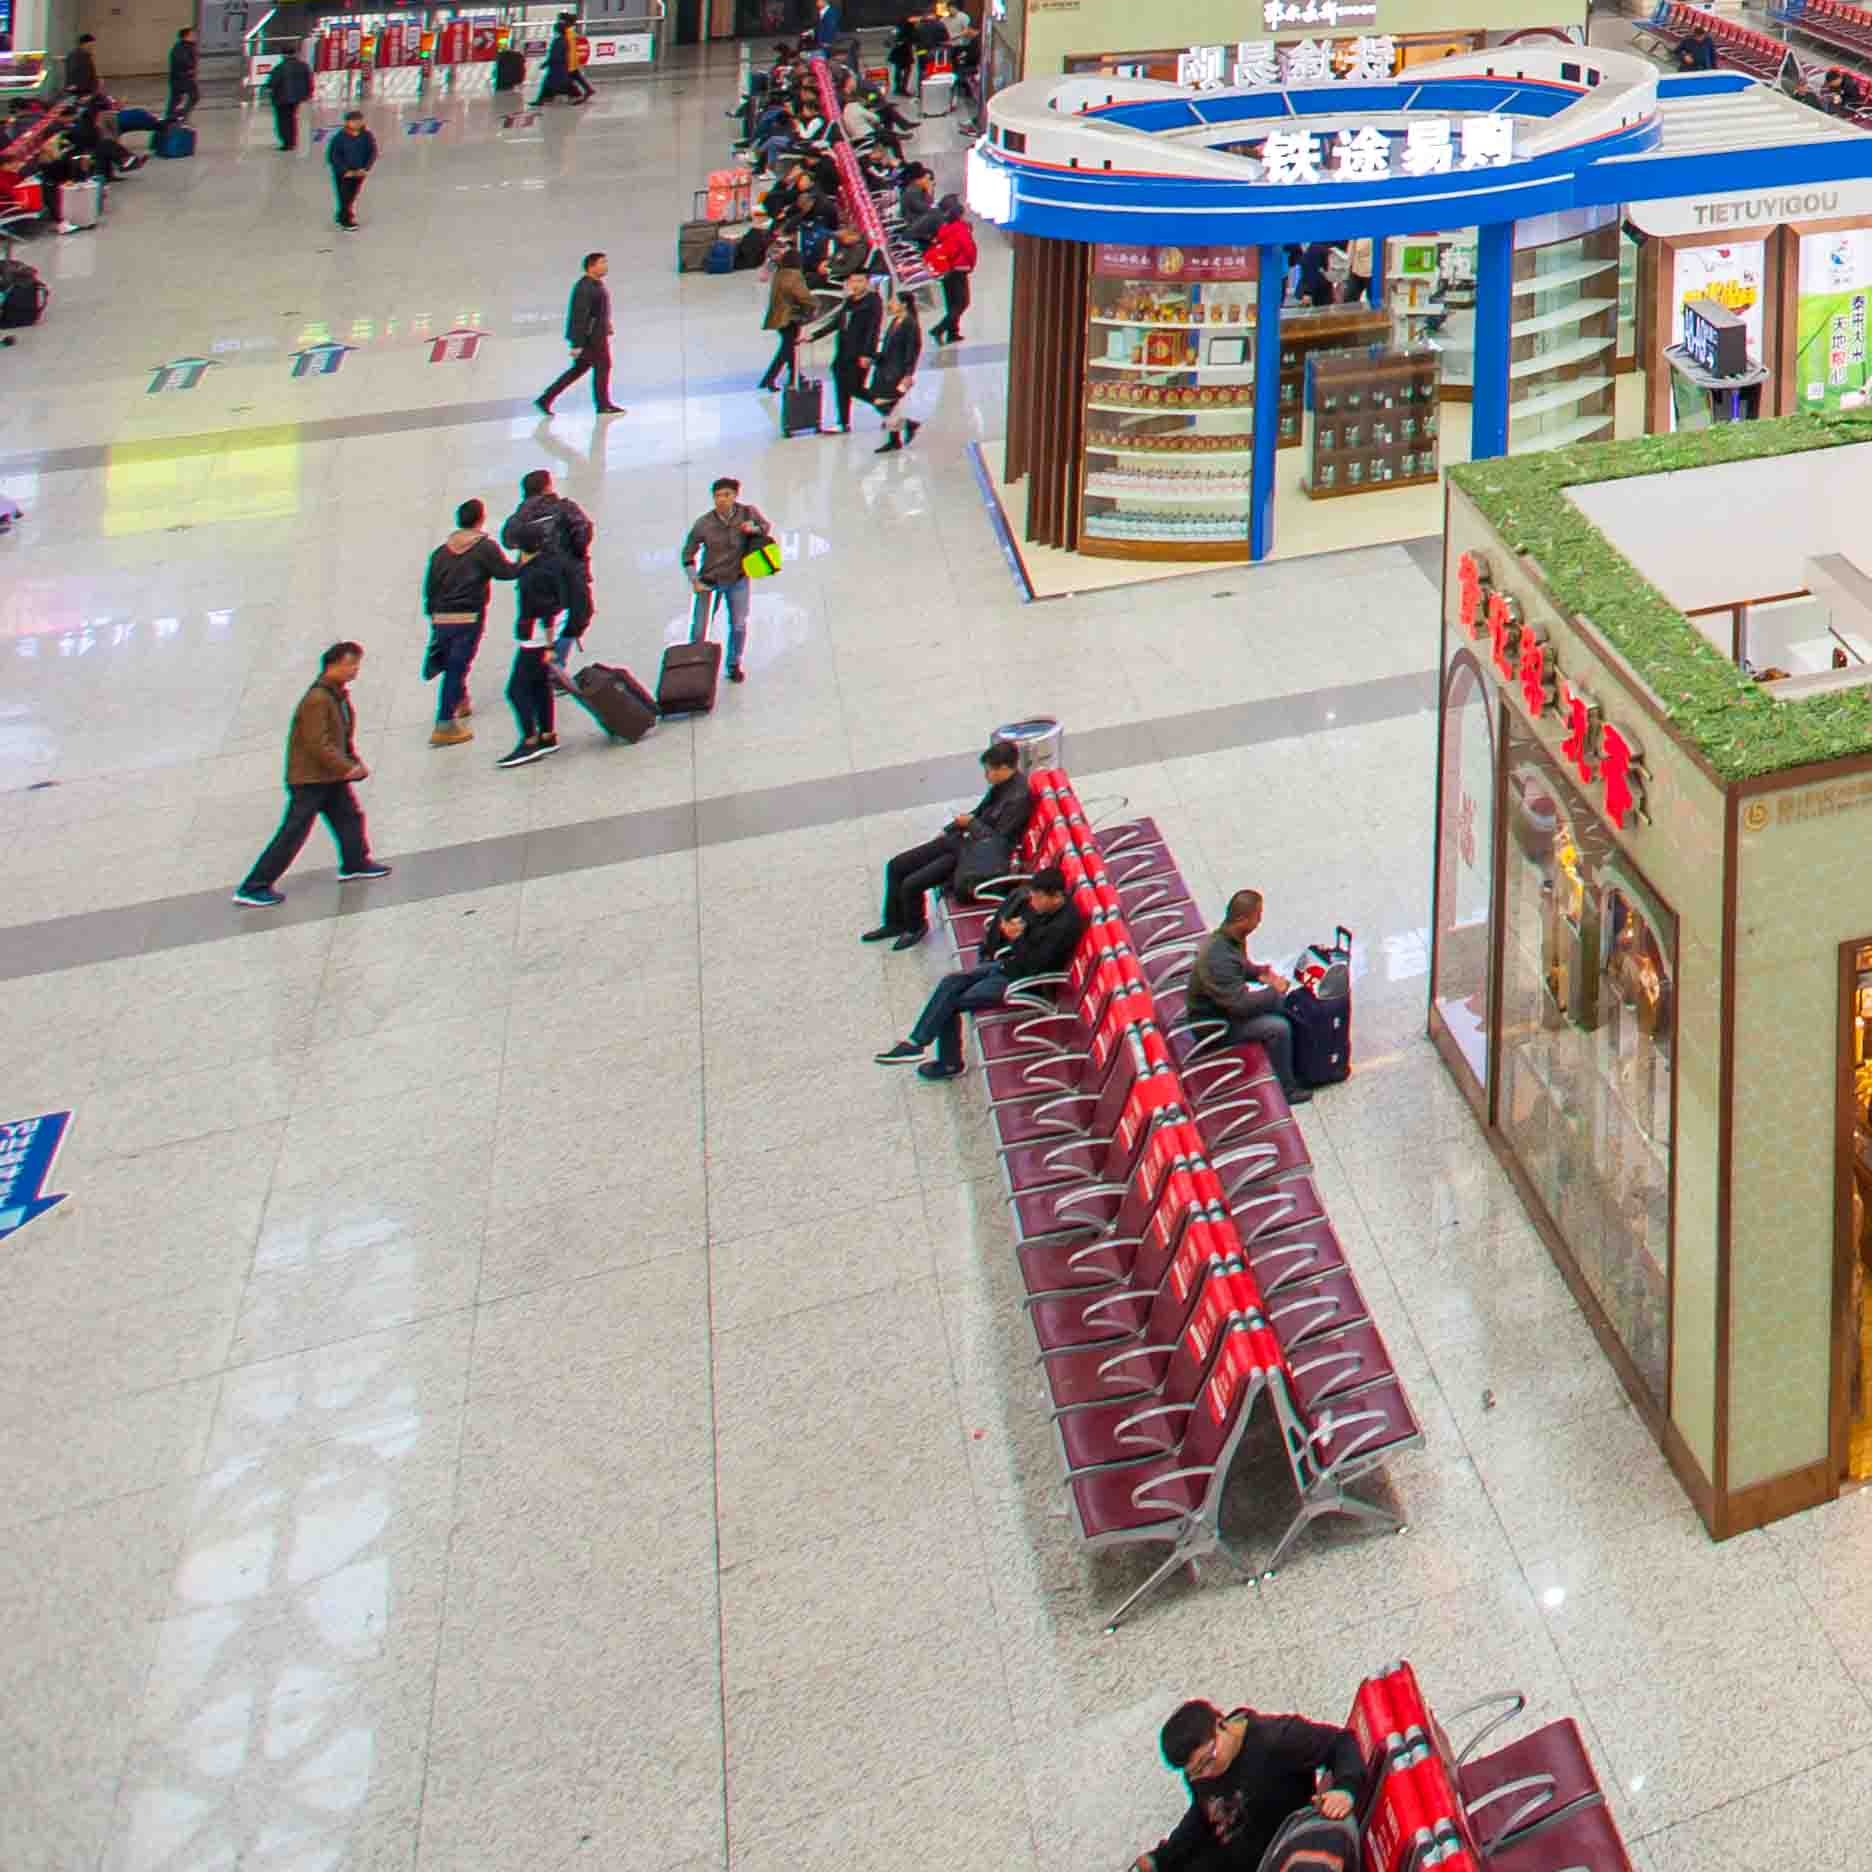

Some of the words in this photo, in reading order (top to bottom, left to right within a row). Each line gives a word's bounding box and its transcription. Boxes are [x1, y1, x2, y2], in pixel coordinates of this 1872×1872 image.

[1262, 116, 1518, 185] 铁途易购
[1693, 191, 1840, 226] TIETUYIGOU
